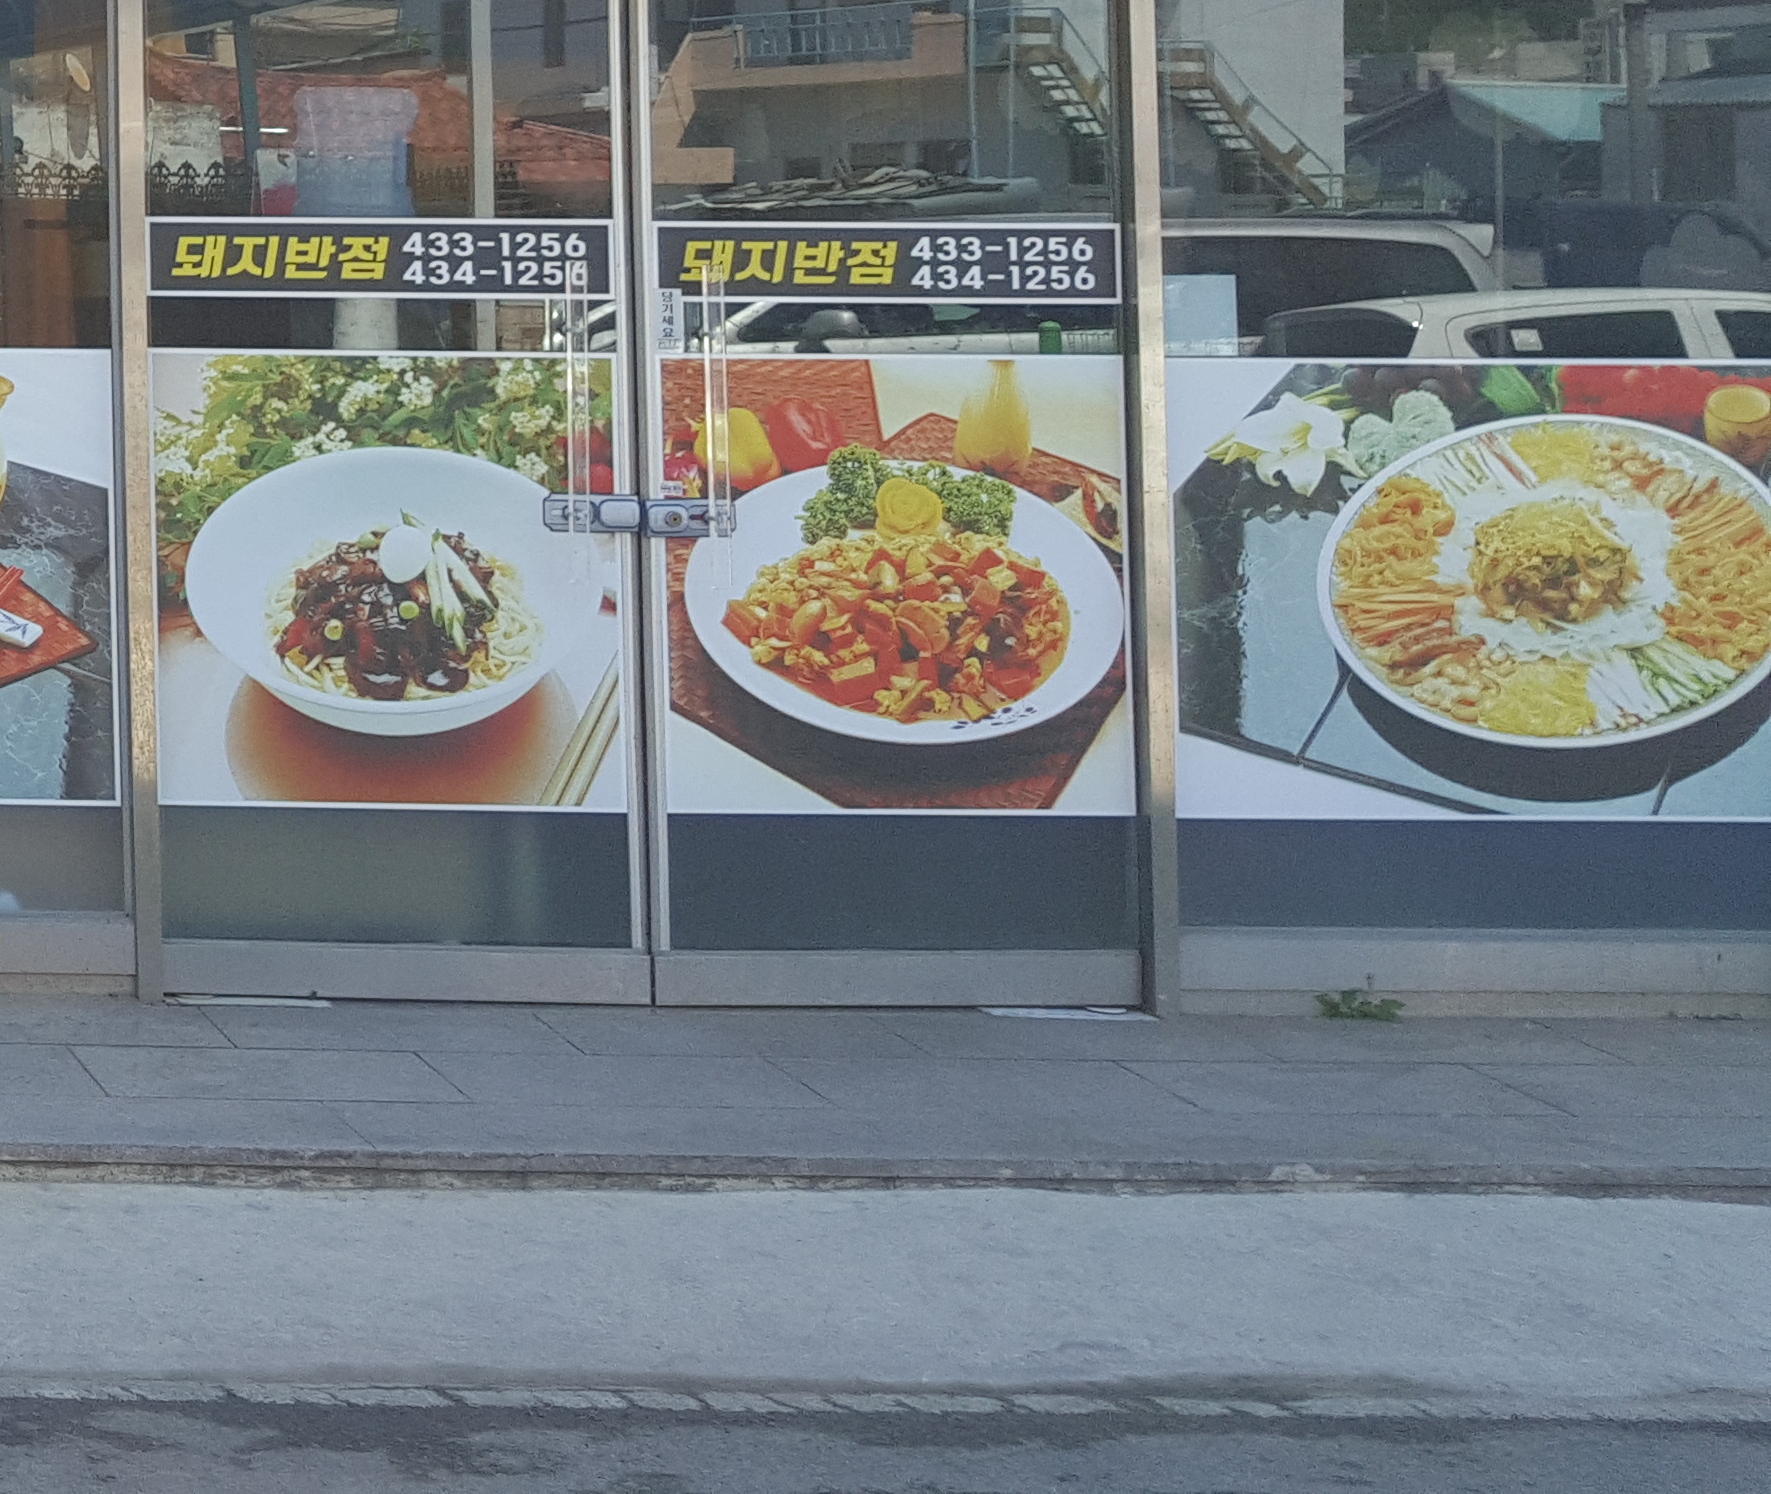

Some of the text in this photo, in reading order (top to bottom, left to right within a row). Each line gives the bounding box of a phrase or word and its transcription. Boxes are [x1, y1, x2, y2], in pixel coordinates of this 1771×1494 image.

[171, 234, 391, 282] 돼지반점
[402, 230, 587, 259] 433-1256
[910, 236, 1094, 264] 433-1256
[401, 260, 590, 288] 434-1256
[678, 239, 899, 287] 돼지반점
[910, 264, 1096, 291] 434-1256
[660, 291, 675, 338] 당기세요
